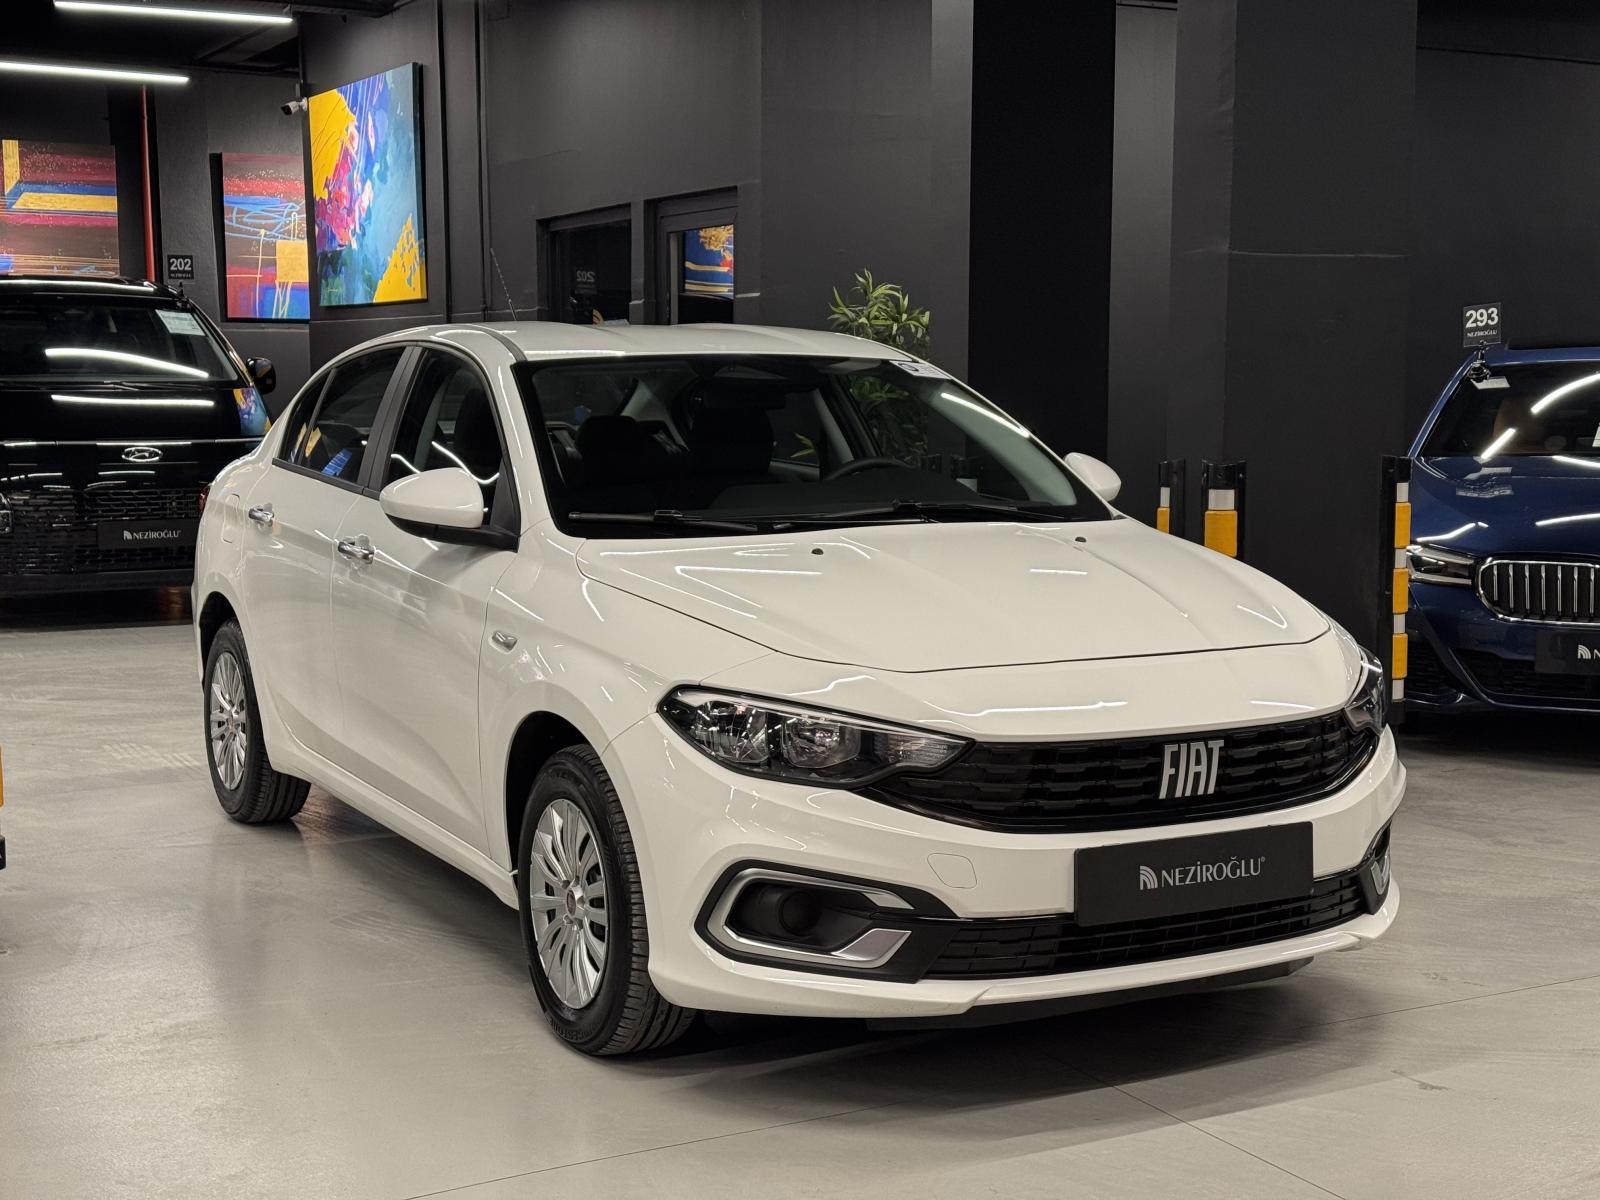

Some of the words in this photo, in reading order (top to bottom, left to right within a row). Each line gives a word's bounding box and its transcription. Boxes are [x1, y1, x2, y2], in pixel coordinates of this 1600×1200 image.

[170, 258, 192, 271] 202
[1465, 307, 1499, 328] 293
[1159, 740, 1224, 799] FIAT
